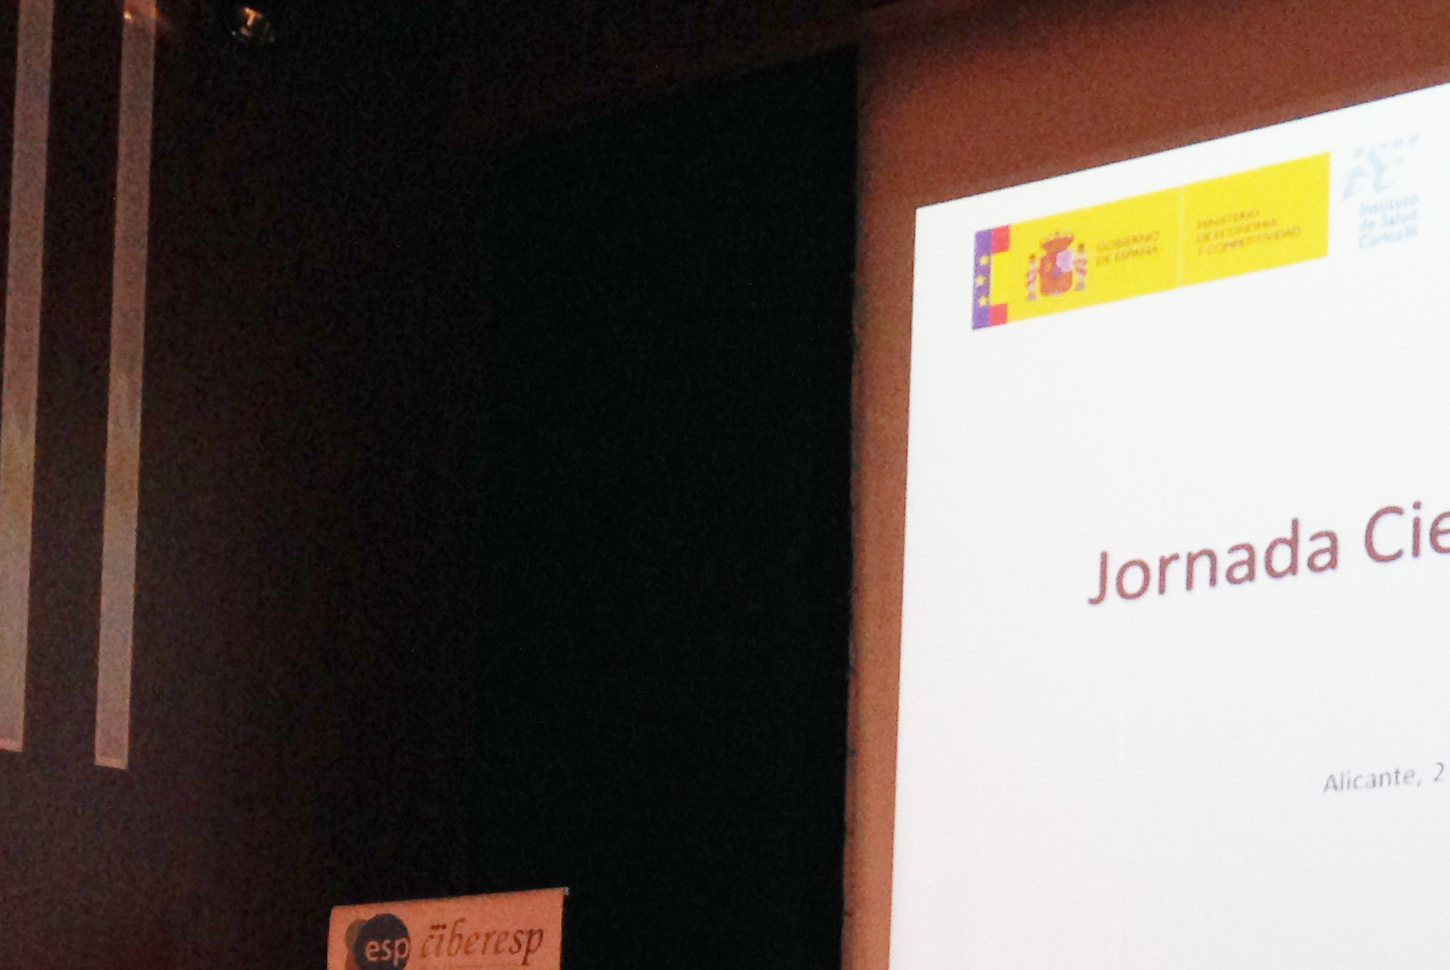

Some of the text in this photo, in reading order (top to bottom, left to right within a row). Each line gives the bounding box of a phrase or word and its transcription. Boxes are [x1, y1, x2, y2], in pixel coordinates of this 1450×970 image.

[1358, 208, 1418, 232] de Salud
[1360, 194, 1419, 215] Instituto
[1088, 517, 1340, 605] Jornada
[1323, 766, 1421, 793] Alicante,
[1433, 761, 1446, 782] 2
[364, 937, 409, 967] esp
[420, 917, 545, 966] ciberesp
